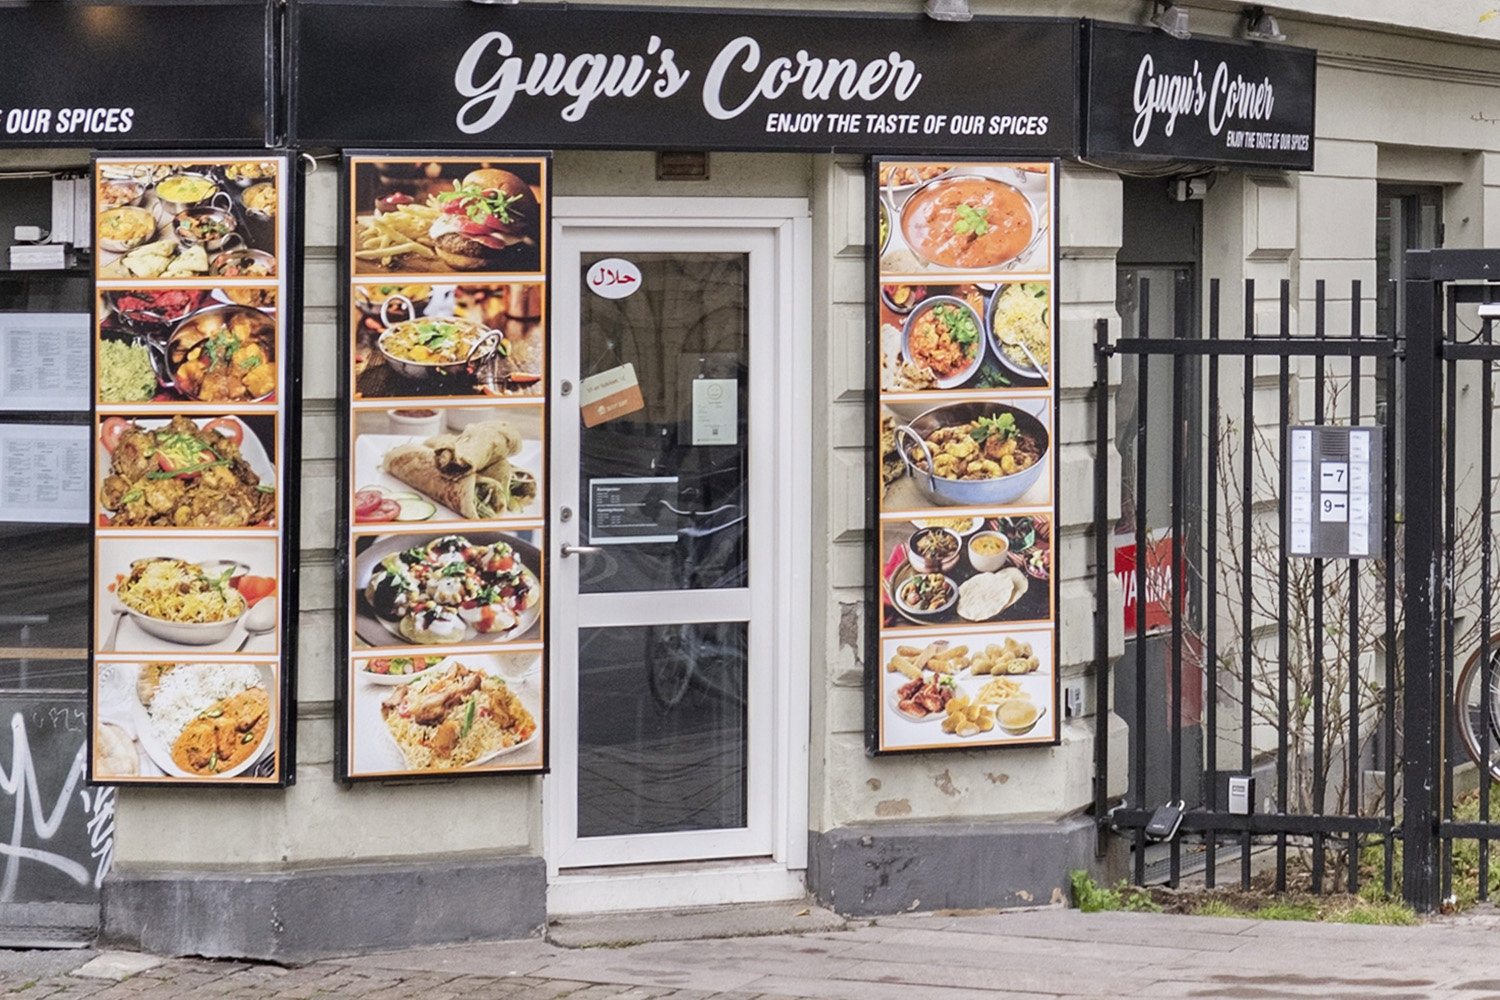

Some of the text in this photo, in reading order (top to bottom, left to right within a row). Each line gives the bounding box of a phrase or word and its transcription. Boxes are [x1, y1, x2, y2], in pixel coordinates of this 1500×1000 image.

[454, 31, 923, 134] Gugu's Corner
[1132, 53, 1275, 148] Gugu's Corner
[6, 107, 134, 134] OUR SPICES
[765, 113, 1049, 136] ENJOY THE TASTE OF OUR SPICES
[1226, 130, 1244, 148] ENJOY
[1256, 132, 1272, 149] TASTE
[592, 267, 636, 286] حلال
[1336, 469, 1344, 482] 7
[1323, 499, 1333, 513] 9
